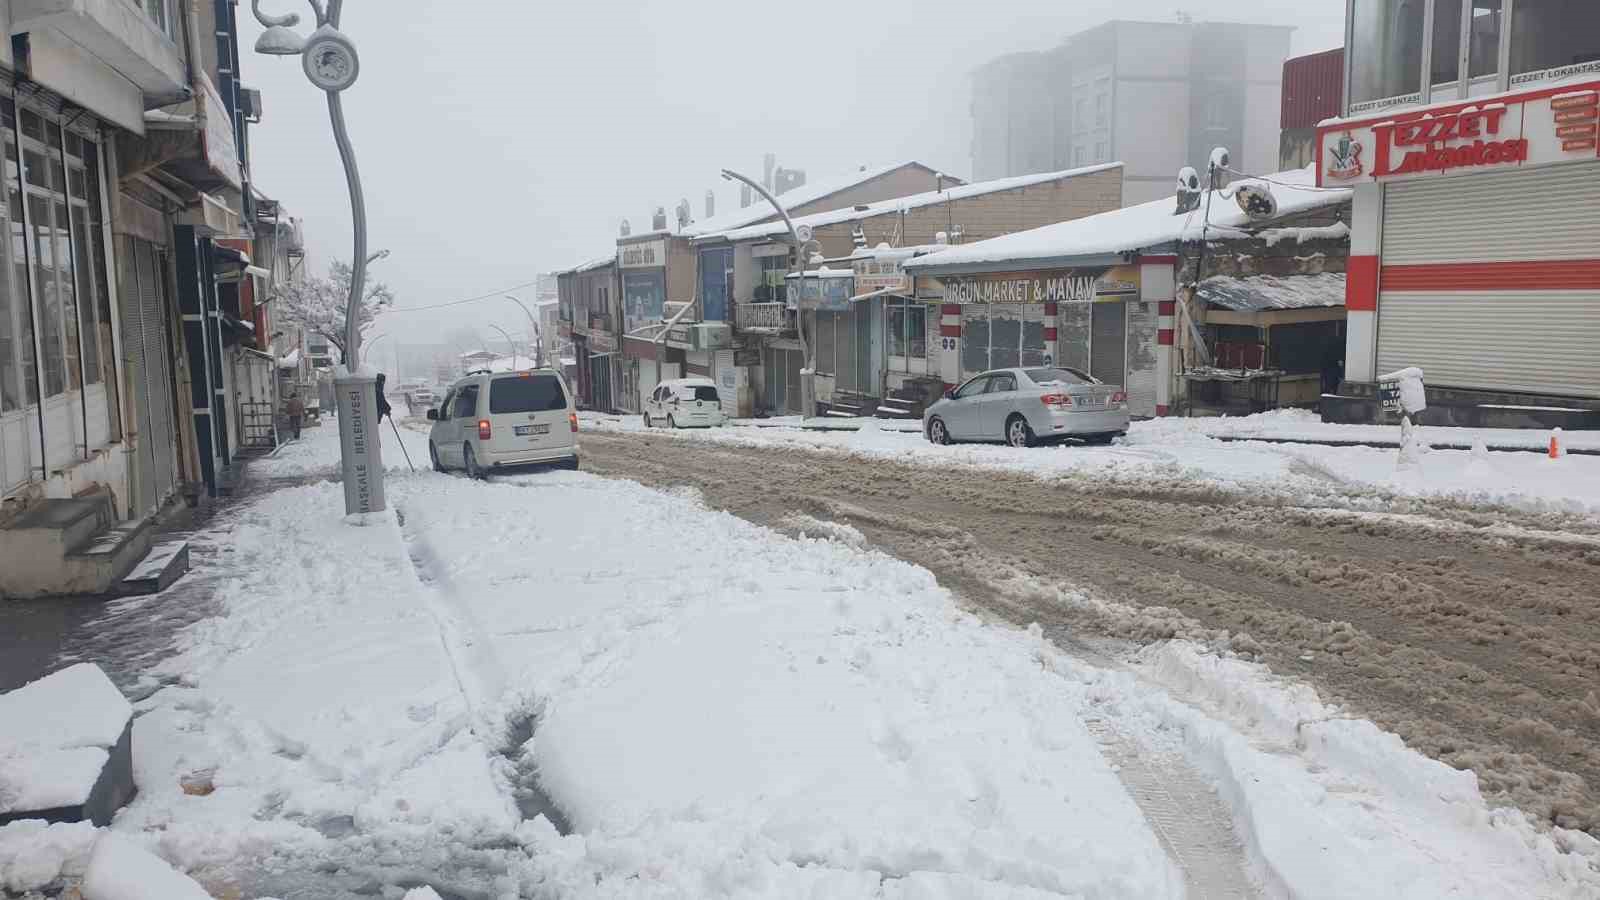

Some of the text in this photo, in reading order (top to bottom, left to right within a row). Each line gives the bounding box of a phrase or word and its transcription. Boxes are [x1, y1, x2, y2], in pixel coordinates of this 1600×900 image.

[1511, 72, 1545, 84] LEZZET
[984, 279, 1030, 303] MARKET
[1033, 279, 1043, 301] &
[1046, 276, 1095, 302] MANAV
